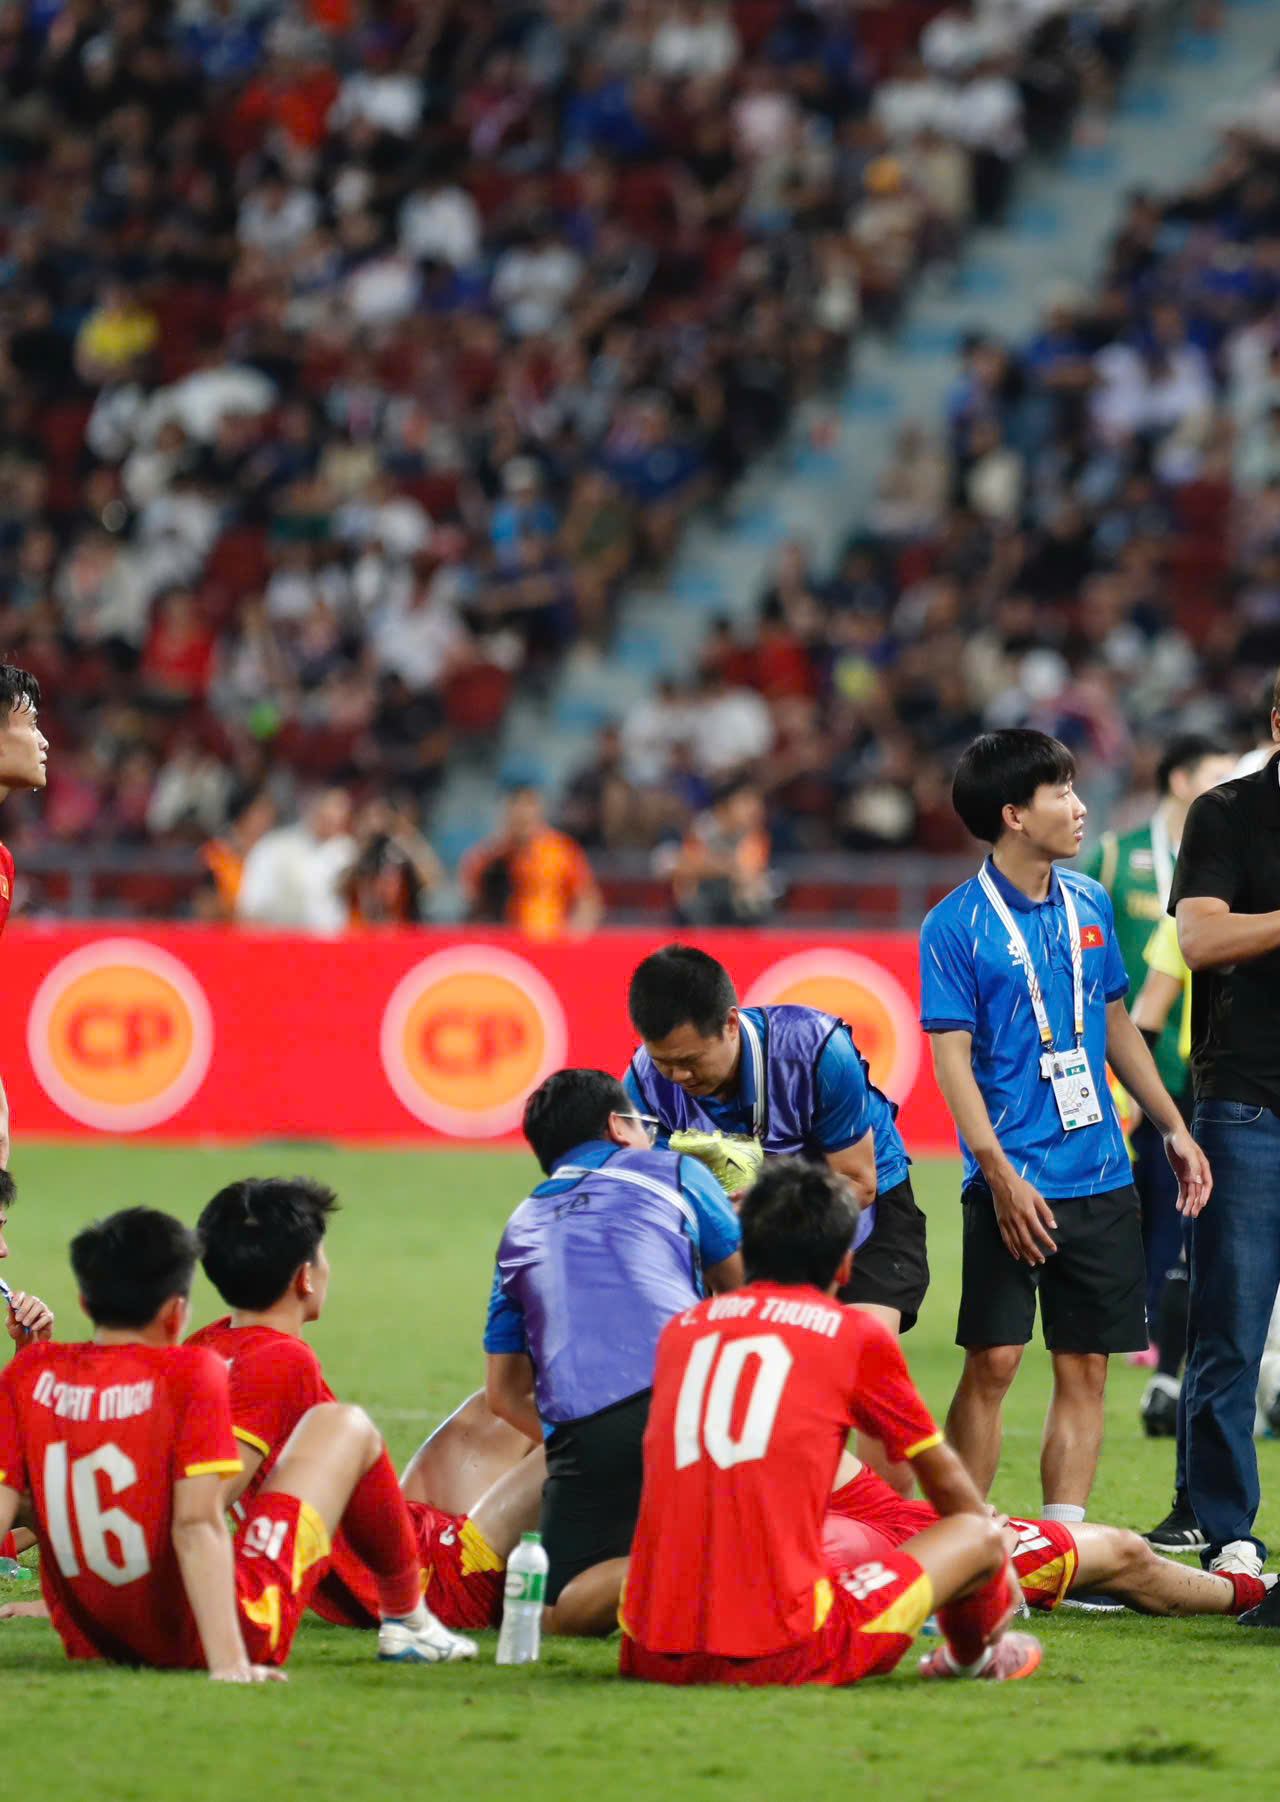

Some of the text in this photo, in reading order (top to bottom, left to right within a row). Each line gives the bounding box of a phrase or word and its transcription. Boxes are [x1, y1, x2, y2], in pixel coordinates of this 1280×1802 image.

[66, 1002, 176, 1072] CP
[419, 1009, 527, 1079] CP
[674, 1331, 794, 1471] 10
[44, 1440, 152, 1587] 16
